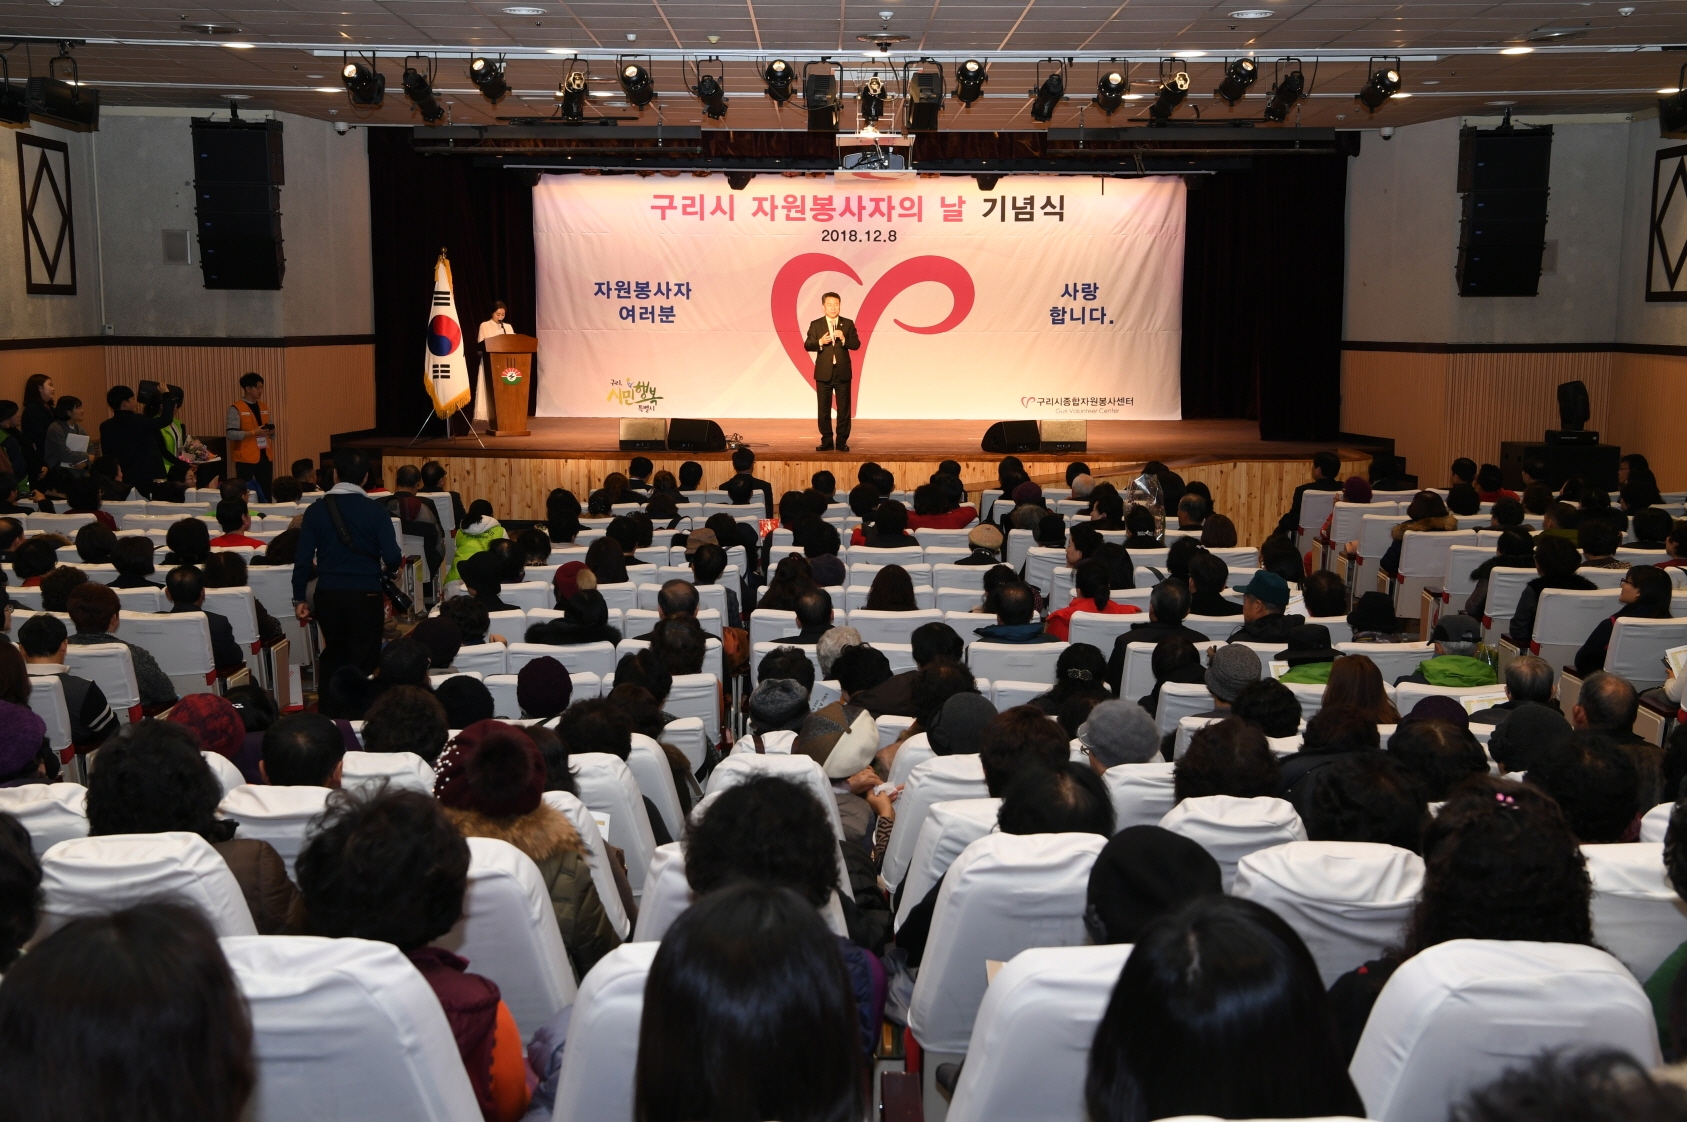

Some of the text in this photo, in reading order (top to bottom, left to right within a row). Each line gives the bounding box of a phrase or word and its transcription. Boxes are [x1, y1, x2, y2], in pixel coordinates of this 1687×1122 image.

[650, 194, 1065, 223] 구리시 자원봉사자의 날 기념식
[821, 229, 898, 243] 2018.12.8
[593, 280, 692, 301] 자원봉사자
[1060, 282, 1100, 301] 사랑
[618, 304, 677, 324] 여러분
[1049, 306, 1114, 325] 합니다.
[1036, 396, 1134, 407] 구리시종합자원봉사센터
